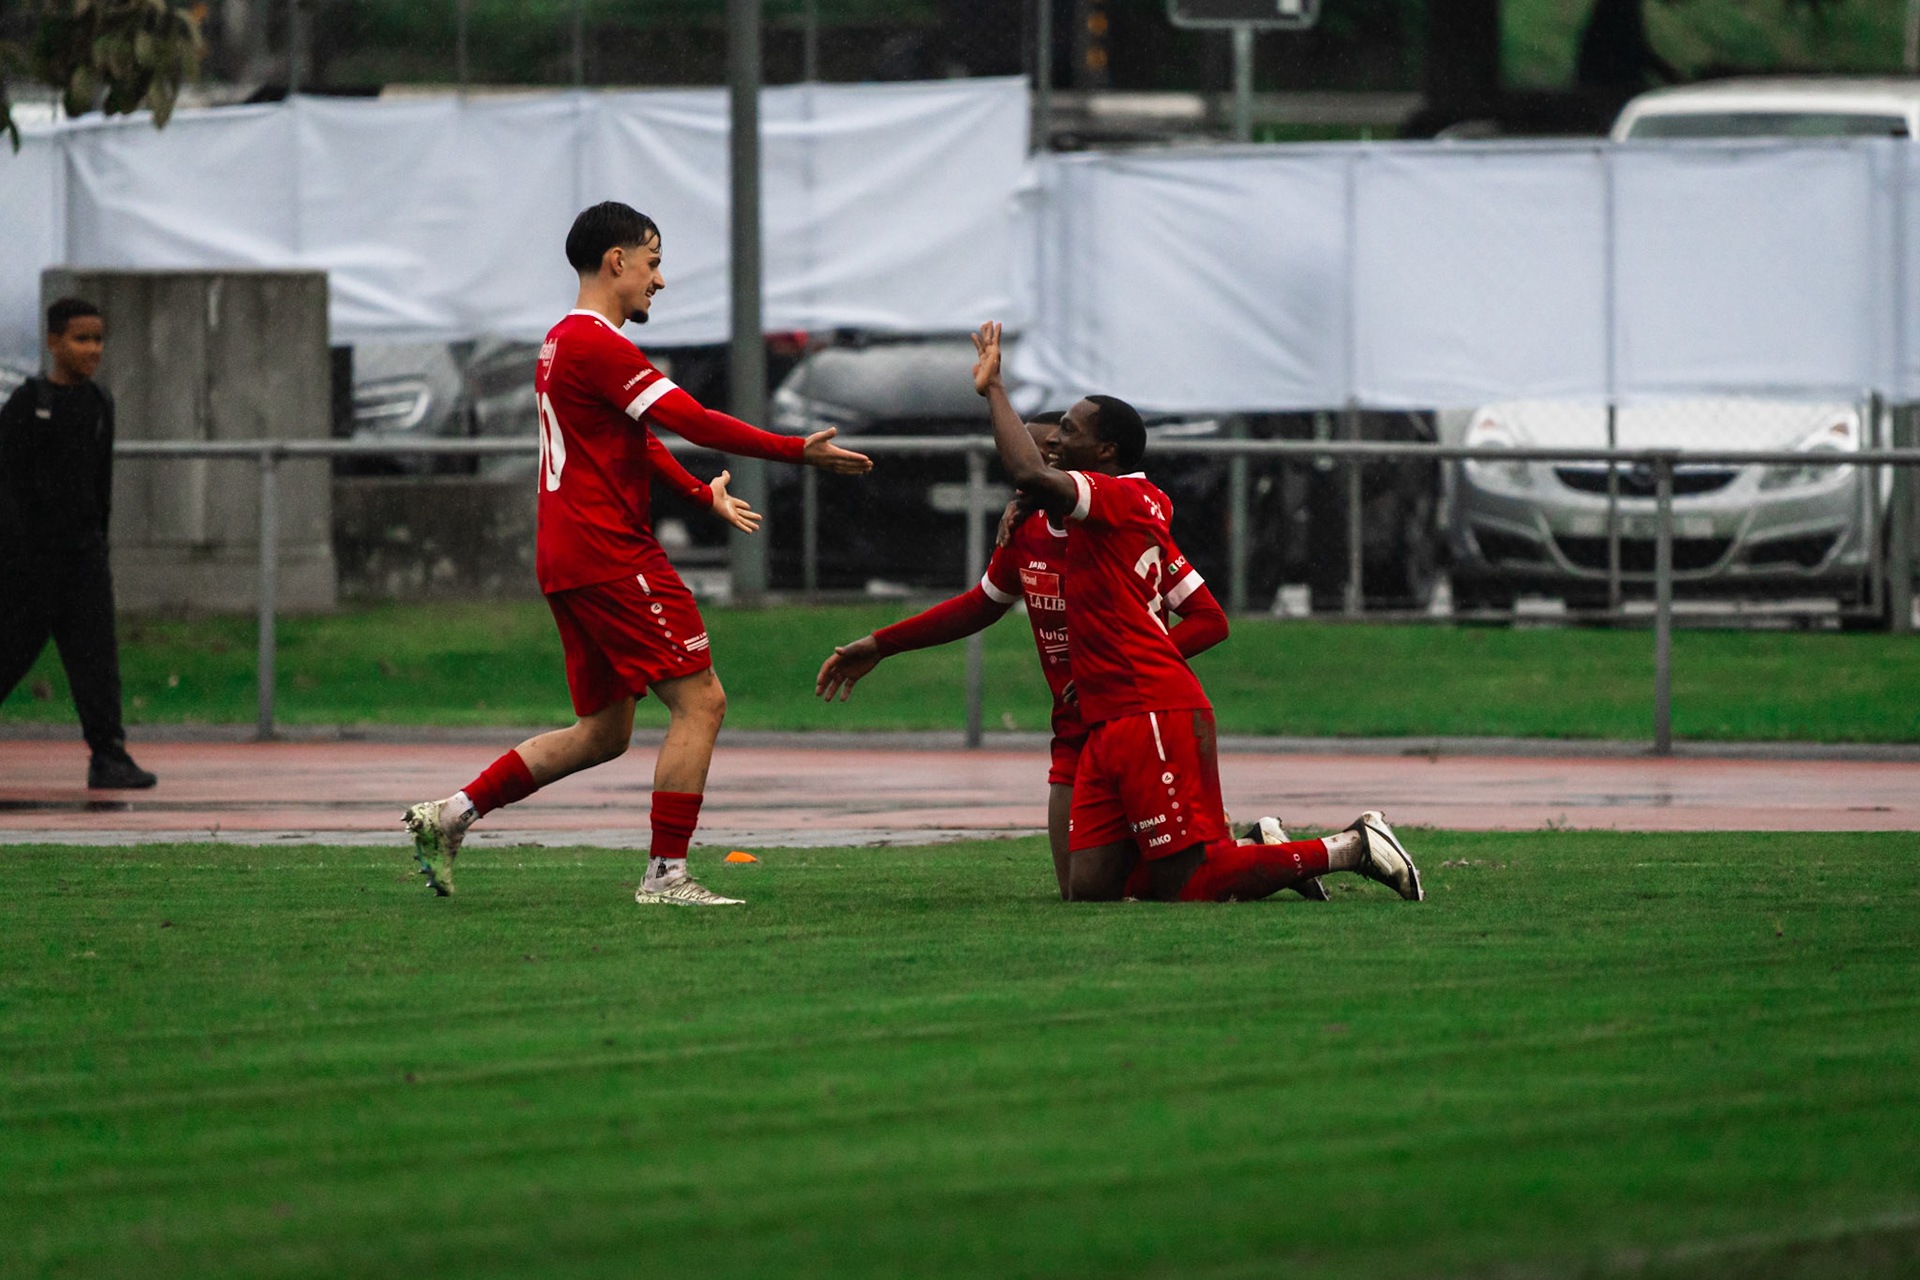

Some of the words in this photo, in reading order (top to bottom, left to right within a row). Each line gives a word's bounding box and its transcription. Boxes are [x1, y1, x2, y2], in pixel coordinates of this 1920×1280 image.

[1028, 560, 1047, 570] JAKO
[1029, 594, 1042, 609] LA
[1139, 813, 1167, 830] DIMAB
[1148, 833, 1172, 848] JAKO
